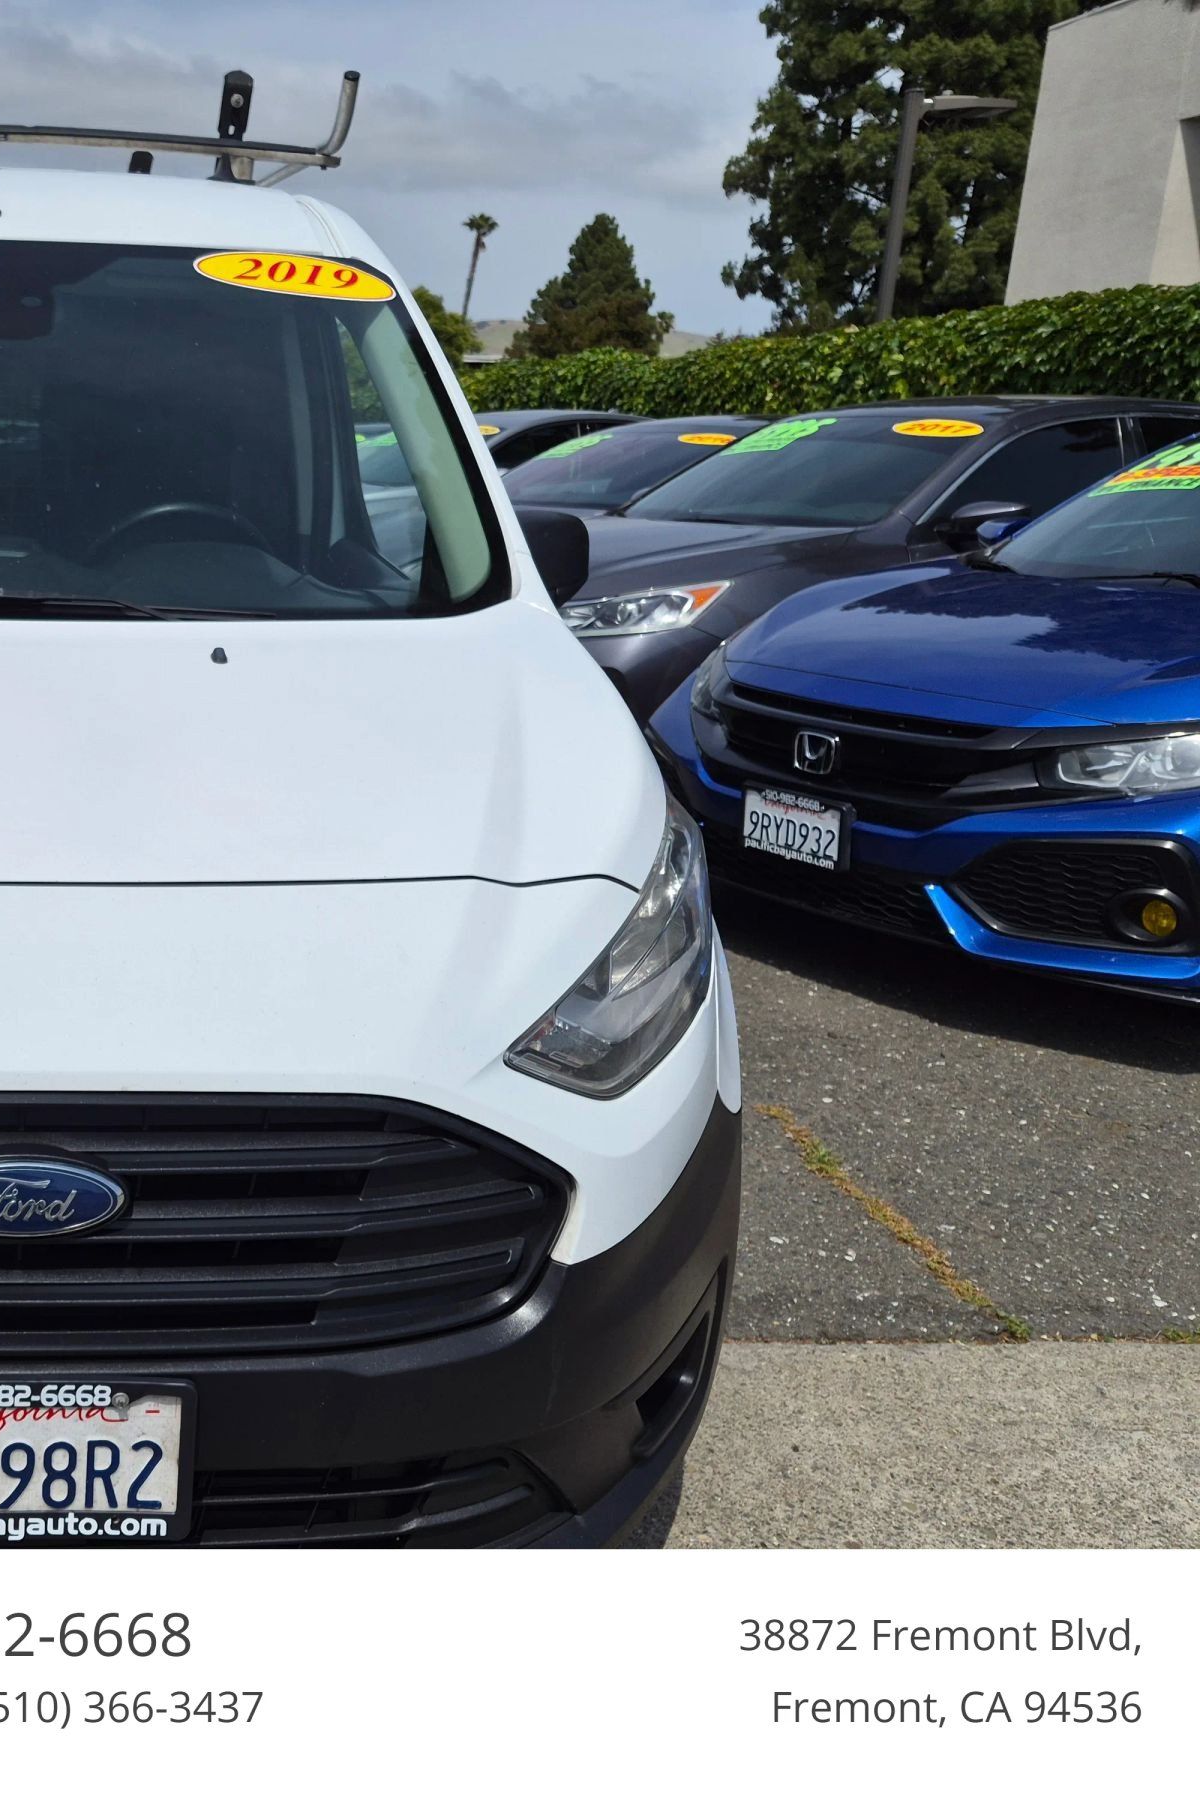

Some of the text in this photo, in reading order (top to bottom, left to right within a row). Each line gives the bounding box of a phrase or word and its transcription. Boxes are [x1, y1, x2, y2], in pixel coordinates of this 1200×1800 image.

[233, 258, 358, 289] 2019
[901, 423, 976, 434] 2017
[765, 788, 821, 812] 510-982-6668
[748, 810, 836, 860] 9RYD932
[744, 837, 835, 870] pacificbayauto.com
